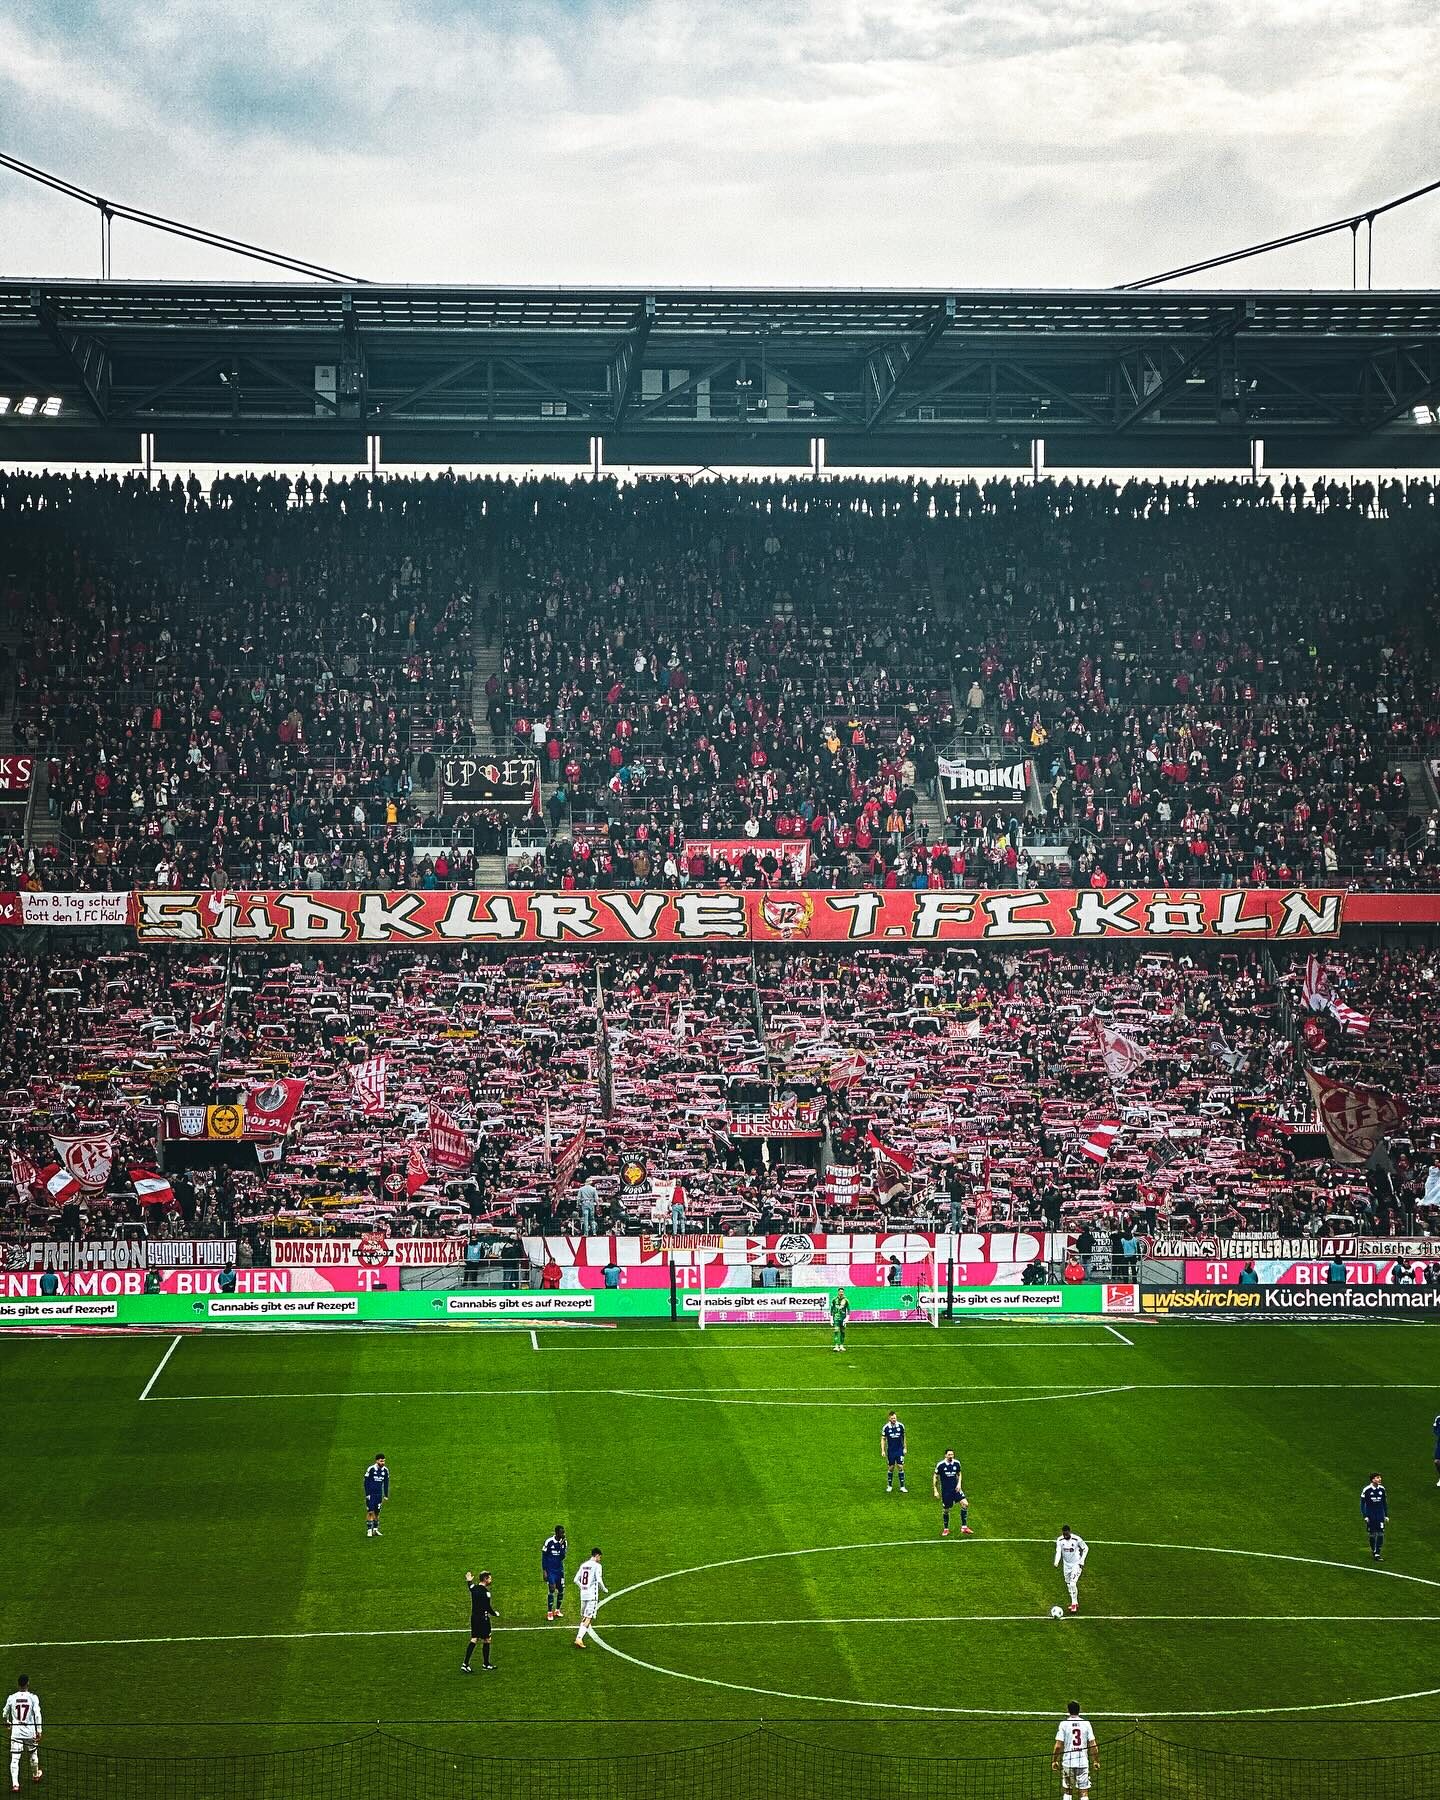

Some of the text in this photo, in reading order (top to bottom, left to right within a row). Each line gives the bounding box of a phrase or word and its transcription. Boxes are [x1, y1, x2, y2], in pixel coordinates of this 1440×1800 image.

[28, 894, 121, 910] Am 8. Tag schuf
[25, 909, 49, 922] Gott
[53, 910, 72, 922] den
[76, 910, 83, 922] 1.
[85, 910, 98, 922] FC
[138, 891, 749, 941] SÜDKURVE
[779, 907, 797, 923] 12
[1072, 888, 1343, 938] KÖLN
[29, 1240, 147, 1270] FRAKTION
[148, 1241, 237, 1265] SEMPER FIDELIS
[275, 1241, 350, 1264] DOMSTADT
[1323, 1240, 1354, 1255] AJJ
[211, 1299, 355, 1312] Cannabis gibt es auf Rezept!
[450, 1299, 497, 1309] Cannabis
[500, 1299, 519, 1310] gibt
[535, 1298, 552, 1308] auf
[554, 1298, 592, 1309] Rezept!
[735, 1296, 755, 1308] gibt
[770, 1296, 787, 1306] auf
[968, 1295, 988, 1306] gibt
[1004, 1294, 1020, 1304] auf
[1022, 1294, 1060, 1305] Rezept!
[1155, 1288, 1440, 1308] wisskirchen Küchenfachmark
[18, 1306, 39, 1317] gibt
[42, 1307, 53, 1315] es
[56, 1305, 73, 1315] auf
[75, 1305, 115, 1316] Rezept!
[582, 1571, 588, 1585] 8
[15, 1704, 29, 1721] 17
[1072, 1729, 1081, 1746] 3
